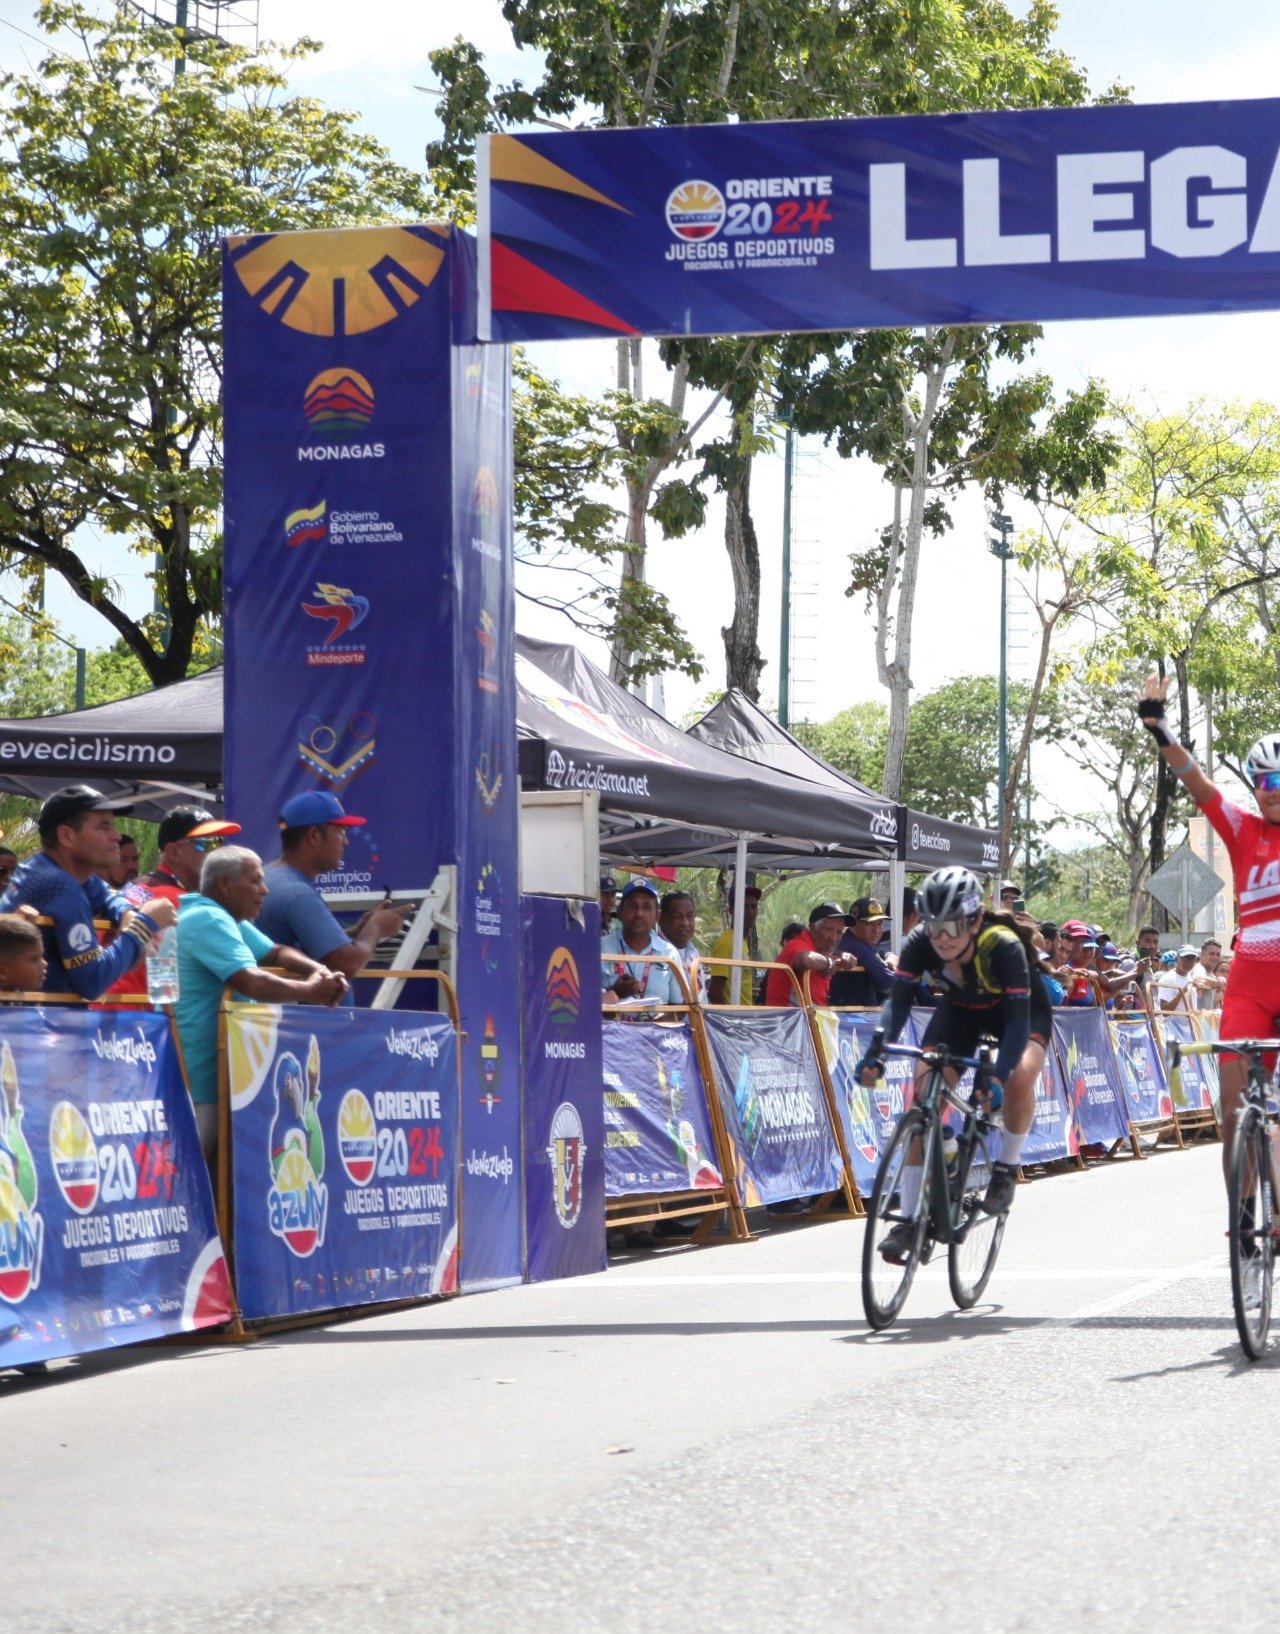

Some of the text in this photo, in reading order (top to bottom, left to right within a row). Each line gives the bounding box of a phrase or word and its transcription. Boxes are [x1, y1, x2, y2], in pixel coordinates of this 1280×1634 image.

[726, 176, 832, 199] ORIENTE
[723, 199, 833, 236] 2024
[665, 238, 835, 261] JUEGOS DEPORTIVOS
[684, 259, 735, 271] NACIONALES
[737, 259, 744, 268] Y
[298, 443, 385, 461] MONAGAS
[330, 511, 379, 523] Gobierno
[330, 522, 394, 534] Bolivariano
[330, 531, 403, 544] de Venezuela
[309, 653, 364, 665] Mindeporte
[566, 761, 650, 796] fvciclismo.net
[545, 1042, 585, 1059] MONAGAS
[89, 1099, 168, 1137] ORIENTE
[374, 1090, 441, 1120] ORIENTE
[759, 1091, 815, 1129] MONAGAS
[377, 1125, 444, 1178] 2024
[101, 1140, 178, 1204] 2024
[344, 1184, 447, 1215] JUEGOS DEPORTIVOS
[64, 1205, 189, 1249] JUEGOS DEPORTIVOS
